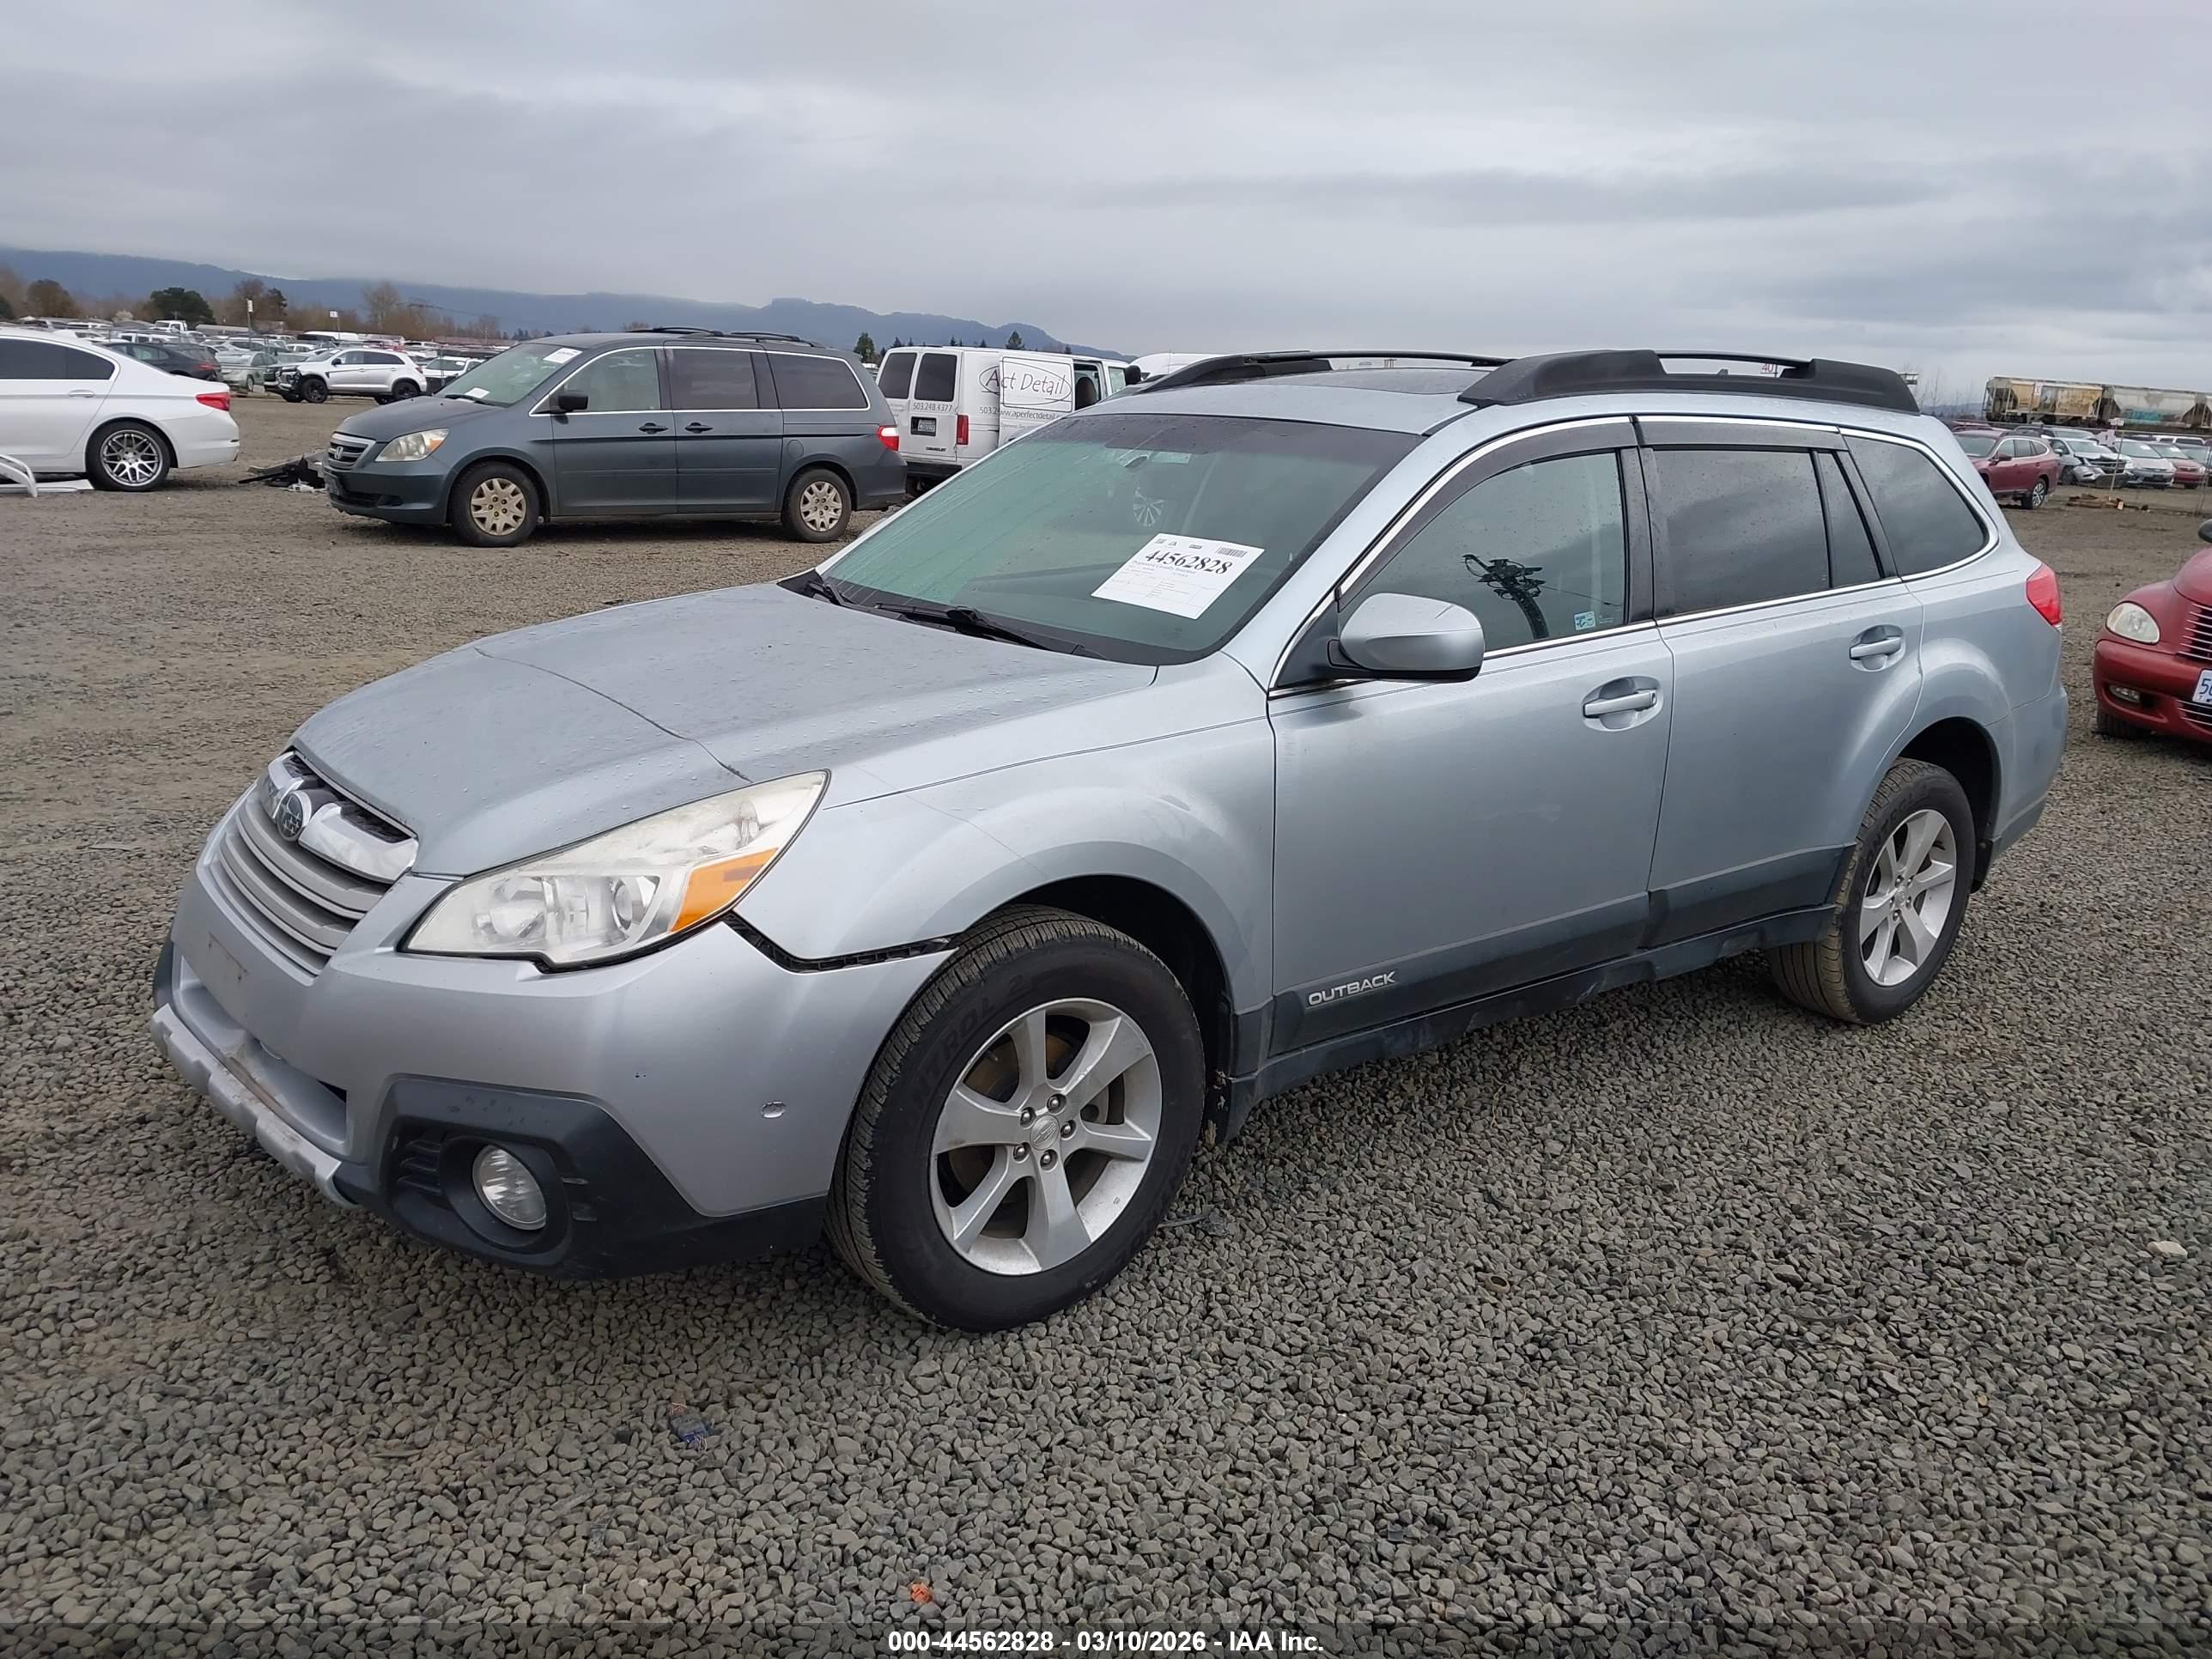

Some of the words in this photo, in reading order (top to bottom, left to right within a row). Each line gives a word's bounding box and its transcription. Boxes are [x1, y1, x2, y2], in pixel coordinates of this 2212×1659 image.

[1020, 373, 1066, 396] Detail
[1145, 550, 1233, 574] 44562828
[1308, 970, 1395, 1006] OUTBACK
